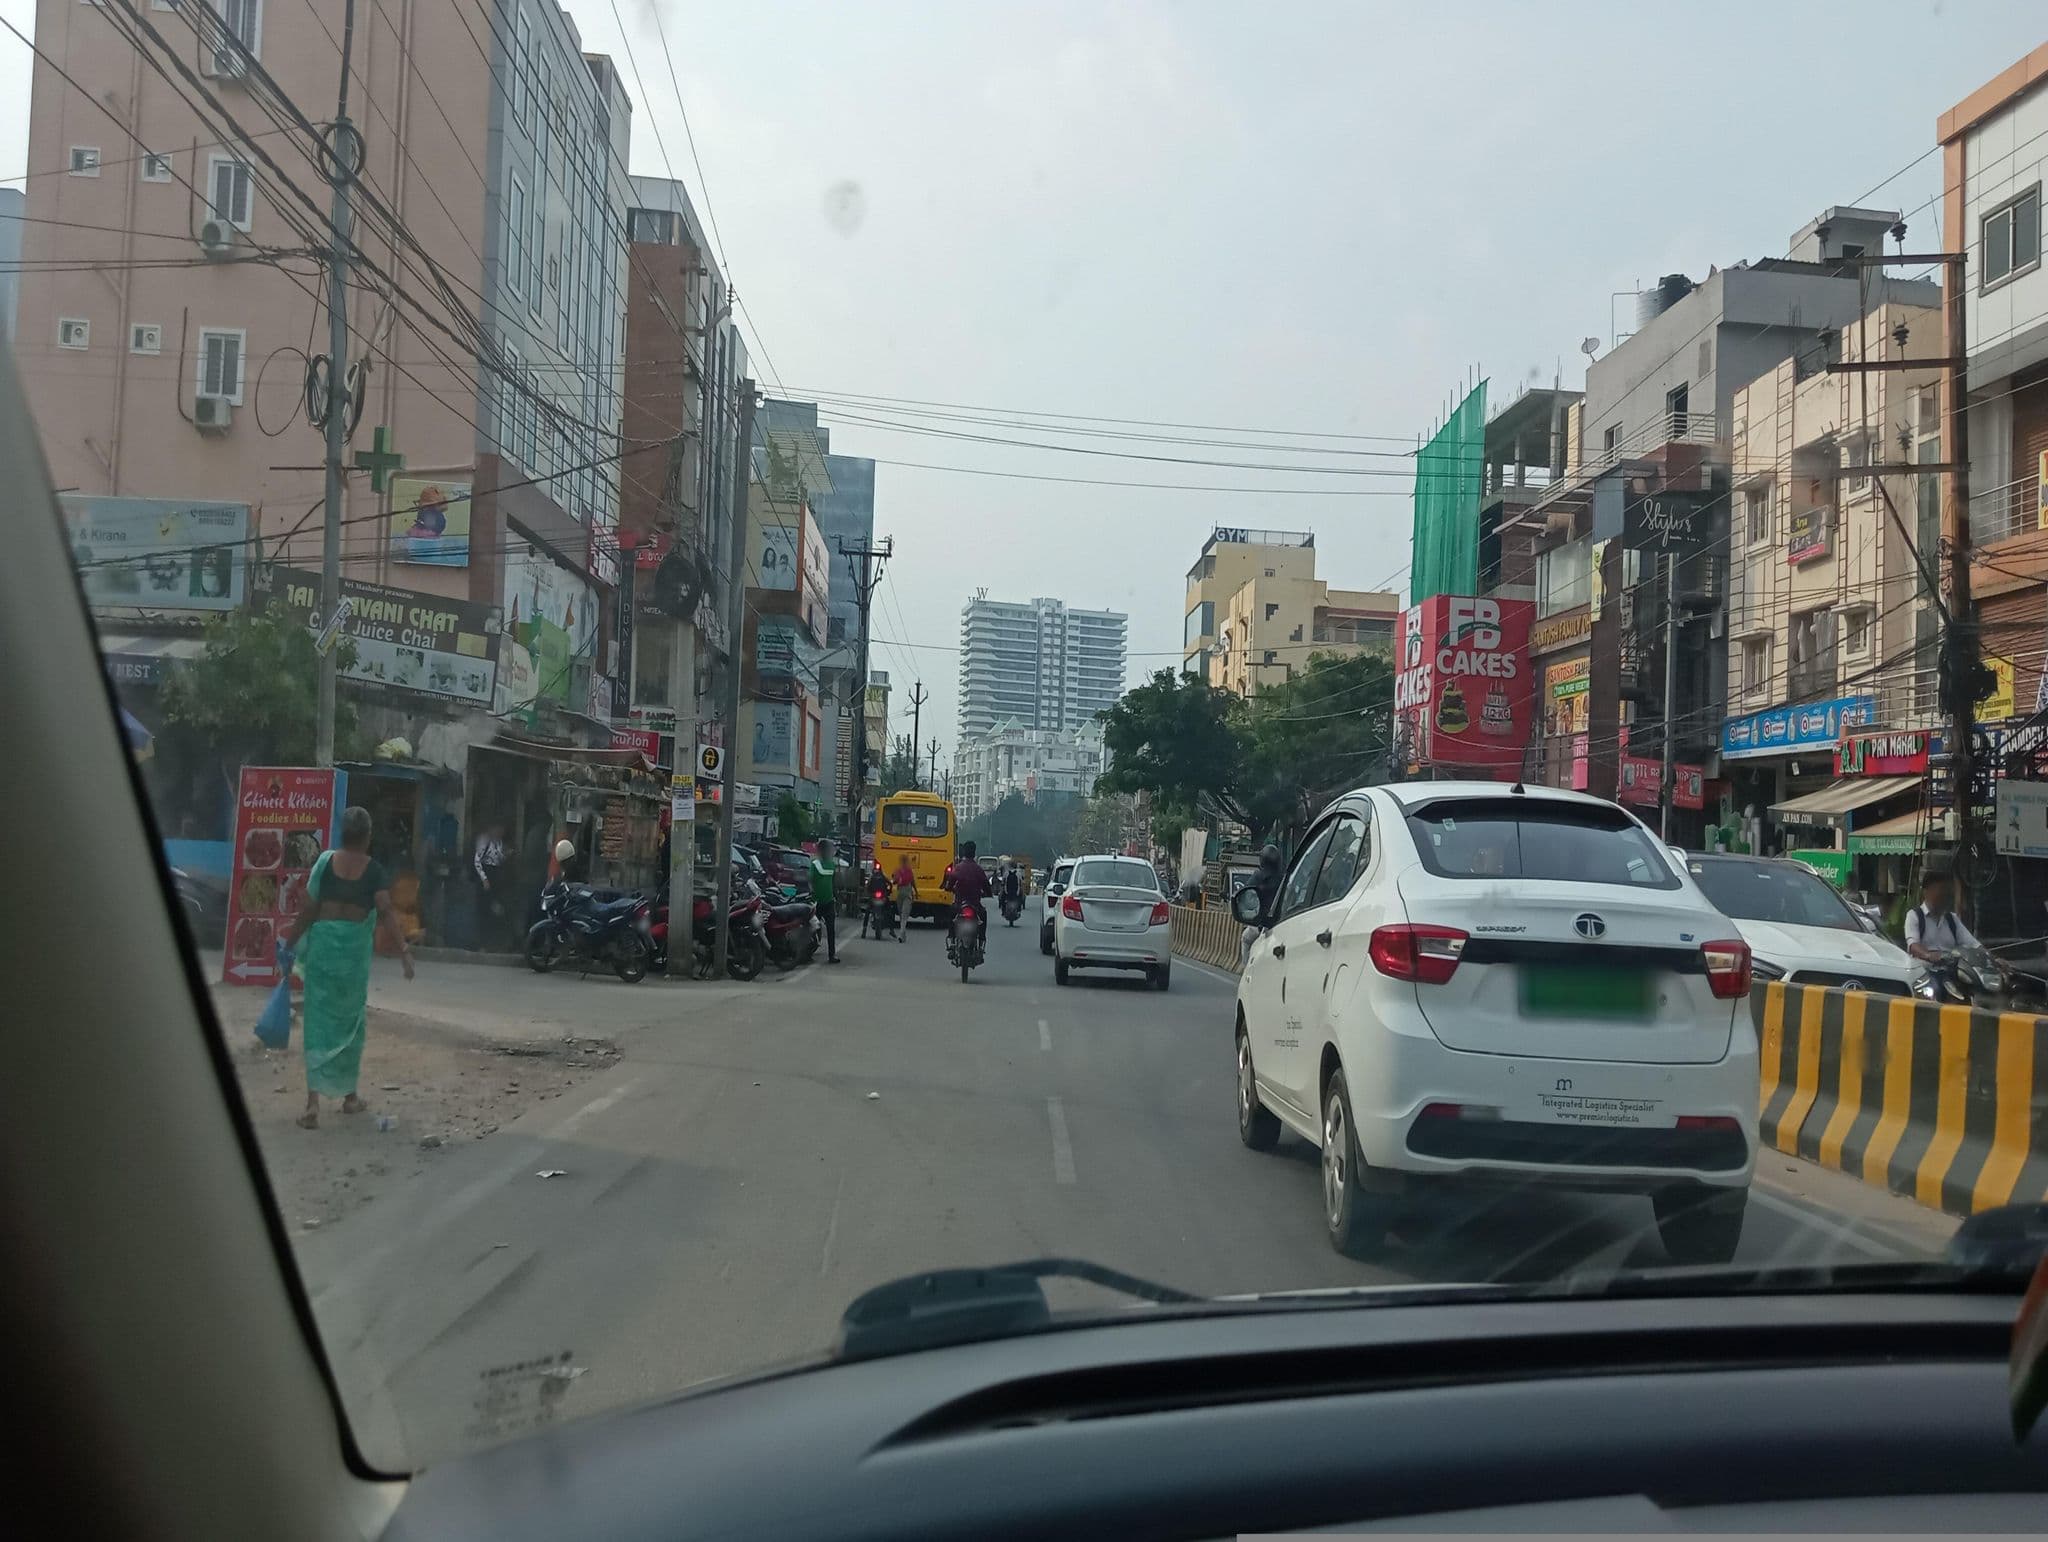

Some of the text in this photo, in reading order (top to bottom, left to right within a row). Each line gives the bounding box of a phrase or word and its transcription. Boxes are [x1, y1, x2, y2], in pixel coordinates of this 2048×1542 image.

[91, 530, 127, 542] Kirana
[1215, 528, 1248, 543] GYM
[409, 607, 460, 634] CHAT
[1449, 596, 1502, 650] FB
[352, 619, 393, 643] Juice
[400, 629, 437, 650] Chai
[1436, 648, 1517, 679] CAKES
[1395, 663, 1433, 712] CAKES
[1872, 738, 1888, 758] PAN
[1890, 734, 1918, 757] MAHAL
[1542, 1095, 1655, 1114] Integrated Logistics Specialist
